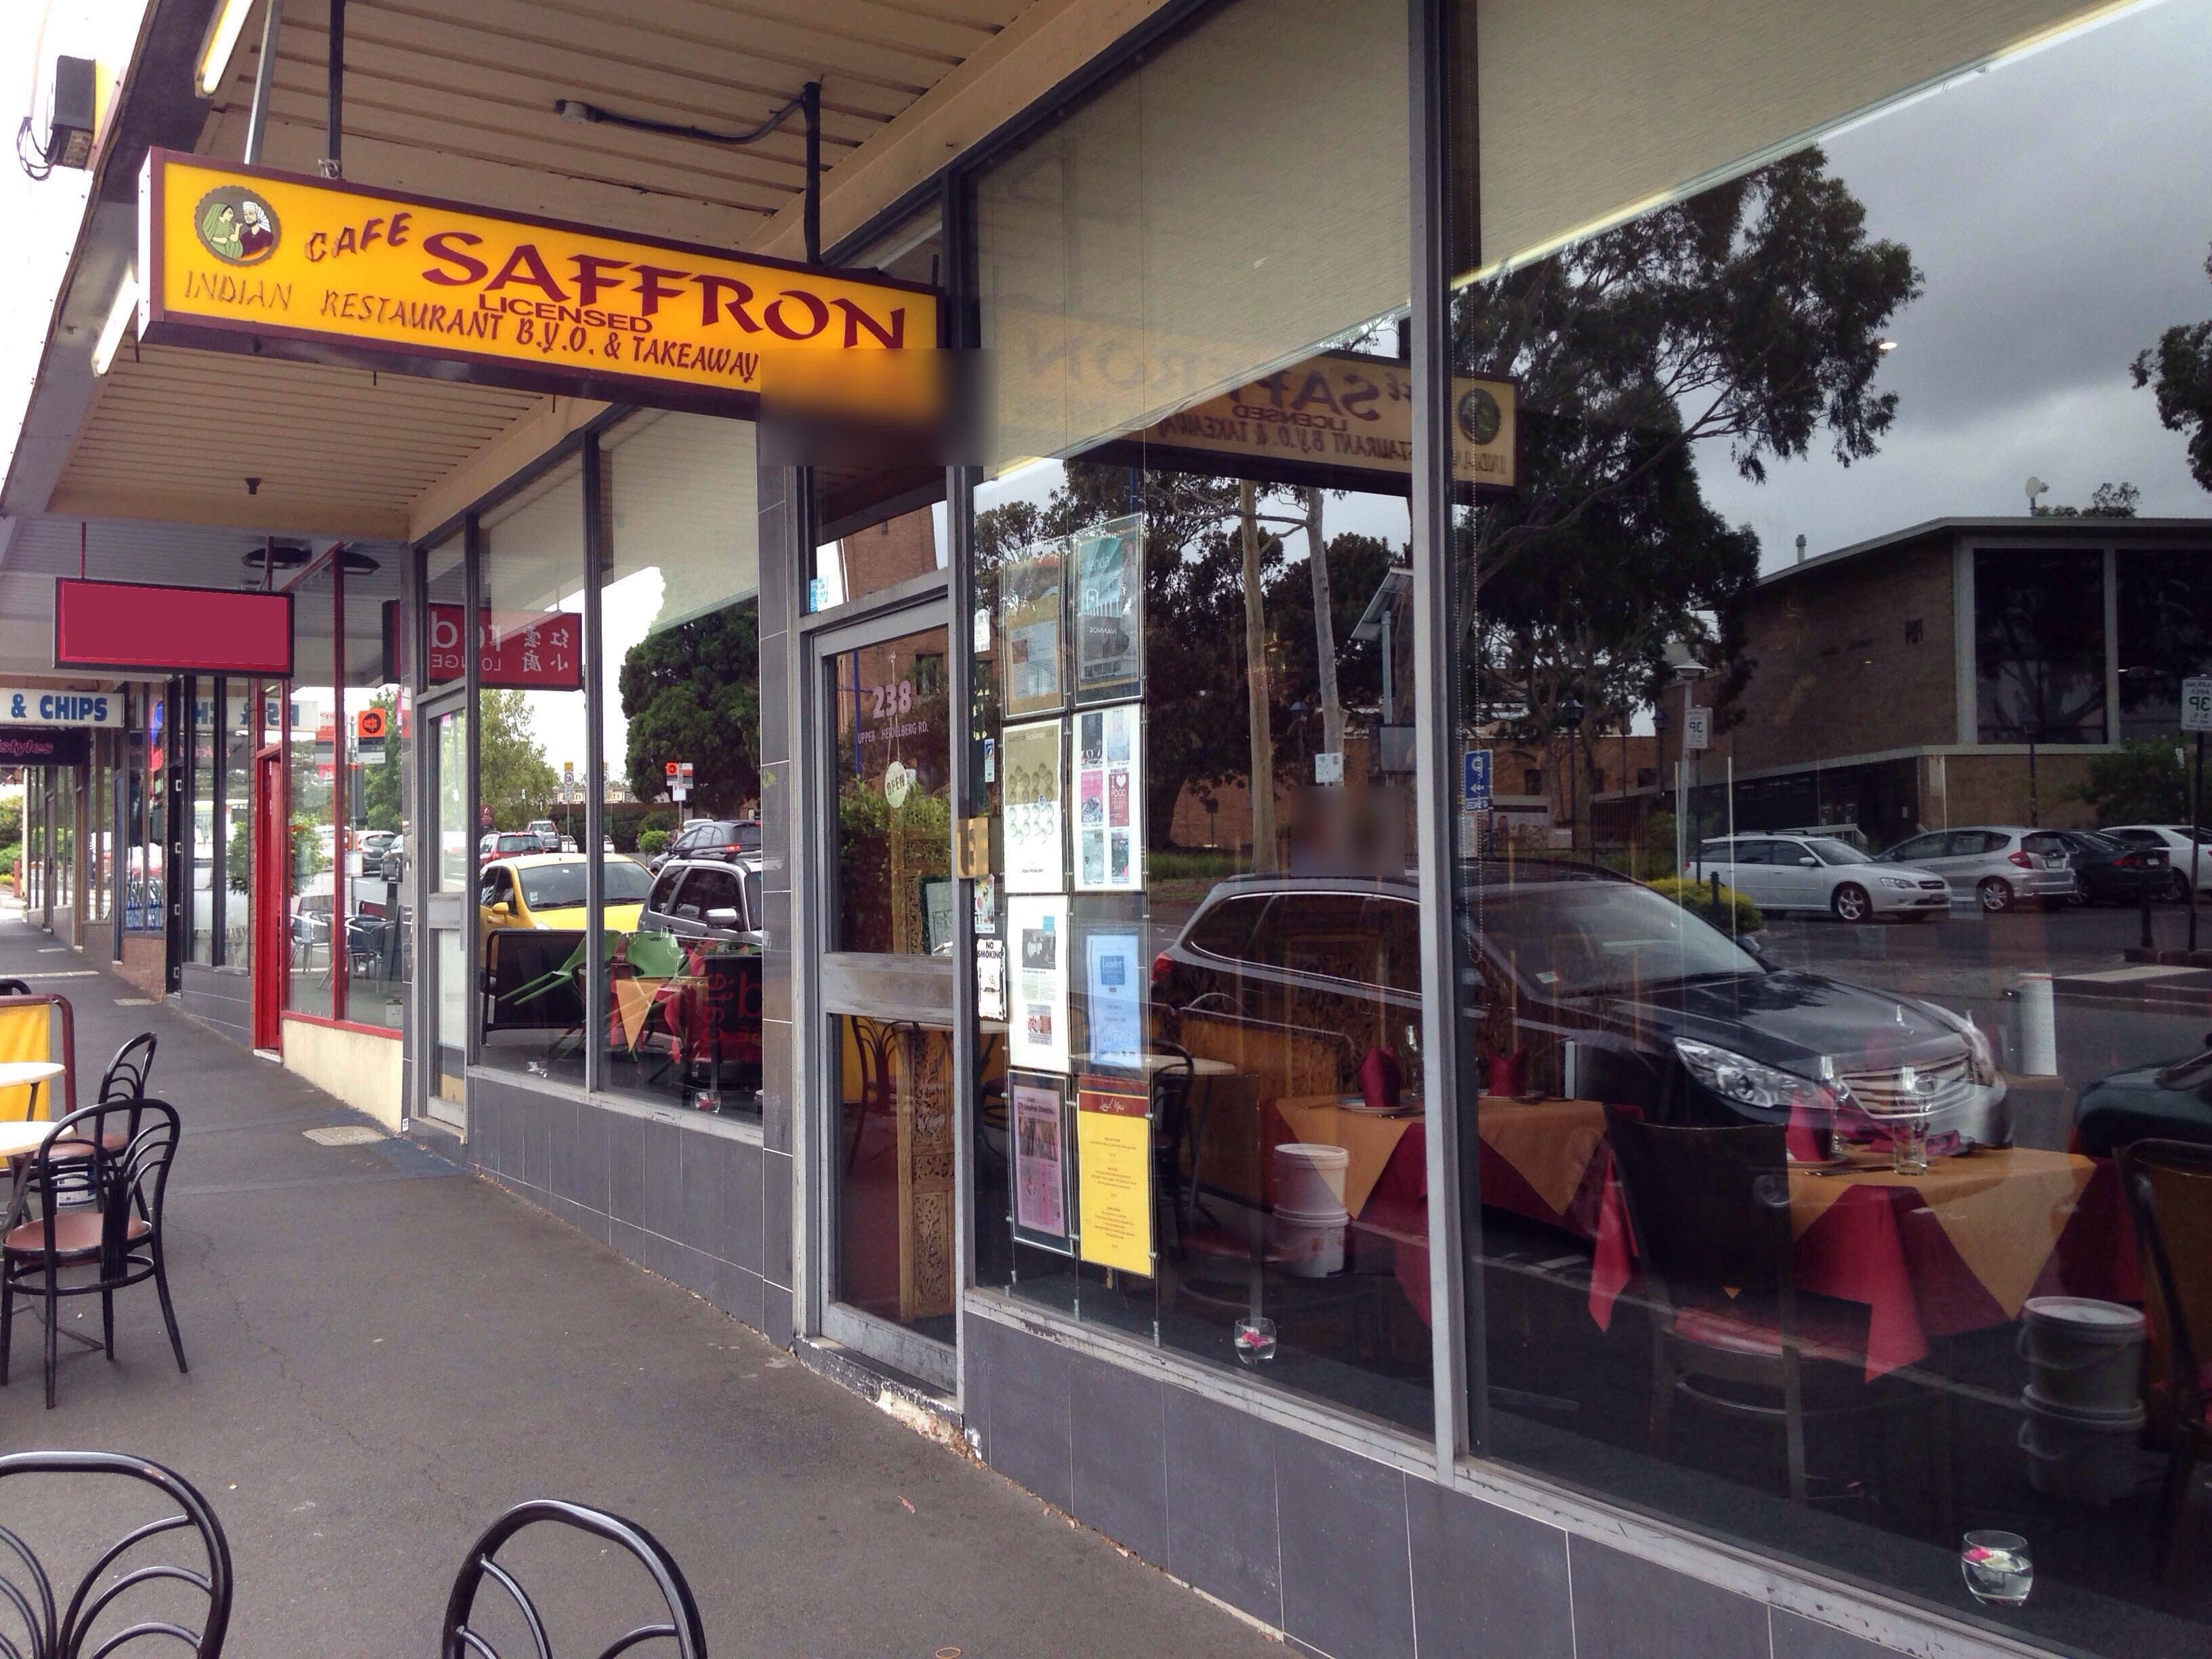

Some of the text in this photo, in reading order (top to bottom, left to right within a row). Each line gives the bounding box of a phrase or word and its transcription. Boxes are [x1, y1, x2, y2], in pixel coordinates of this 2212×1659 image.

[305, 212, 905, 349] CAFE SAFFRON
[184, 271, 759, 384] INDIAN RESTAURANT B.Y.O. & TAKEAWAY
[479, 294, 653, 333] LICENSED
[11, 693, 108, 722] & CHIPS
[872, 680, 912, 719] 238
[857, 731, 875, 744] UPPER
[882, 723, 917, 739] HEIDELBERG
[886, 774, 905, 795] OPEN
[977, 949, 1003, 960] SMOKING
[986, 941, 994, 949] NO
